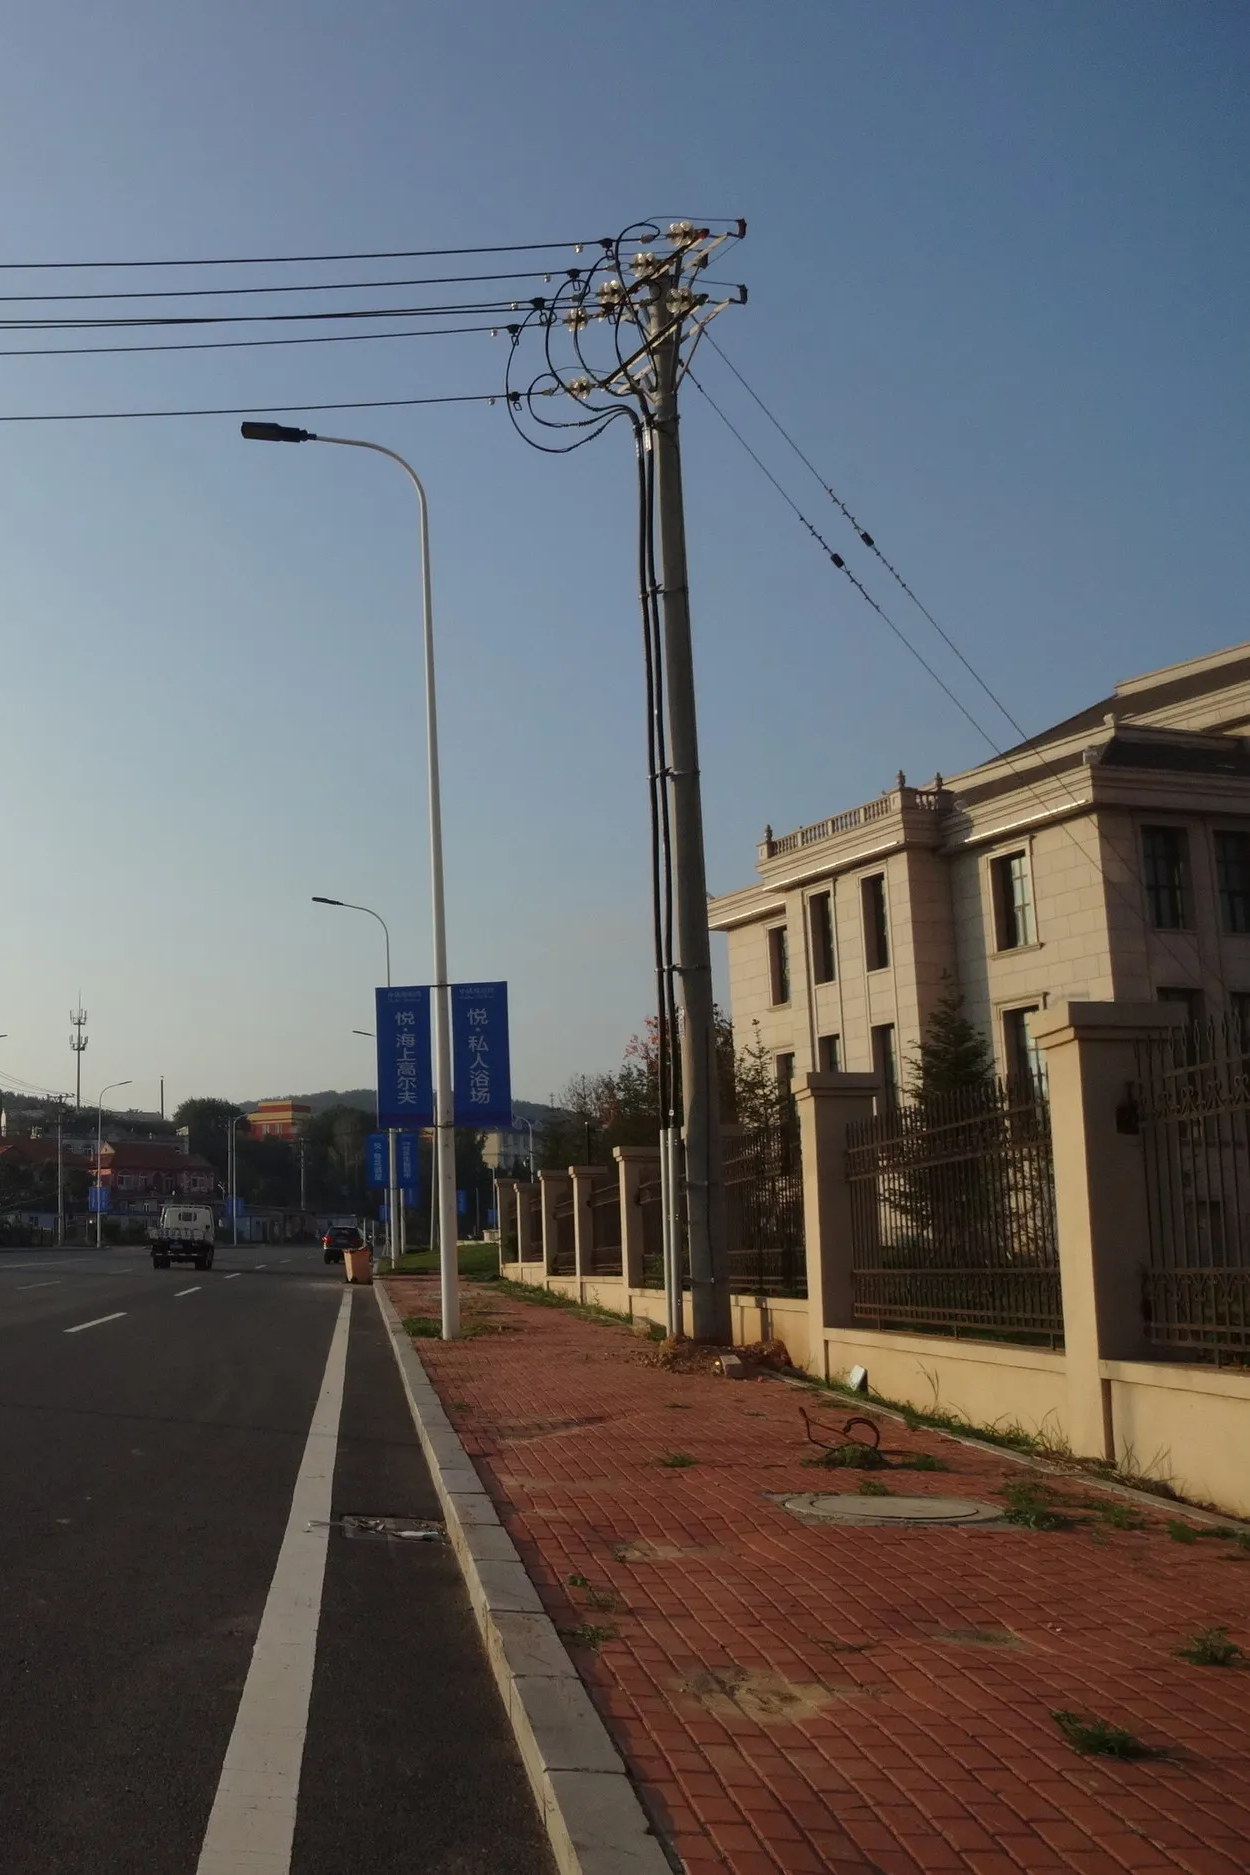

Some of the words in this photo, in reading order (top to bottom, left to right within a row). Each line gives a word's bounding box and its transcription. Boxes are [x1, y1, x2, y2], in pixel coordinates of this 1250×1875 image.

[467, 1007, 490, 1104] 悦·私人浴场
